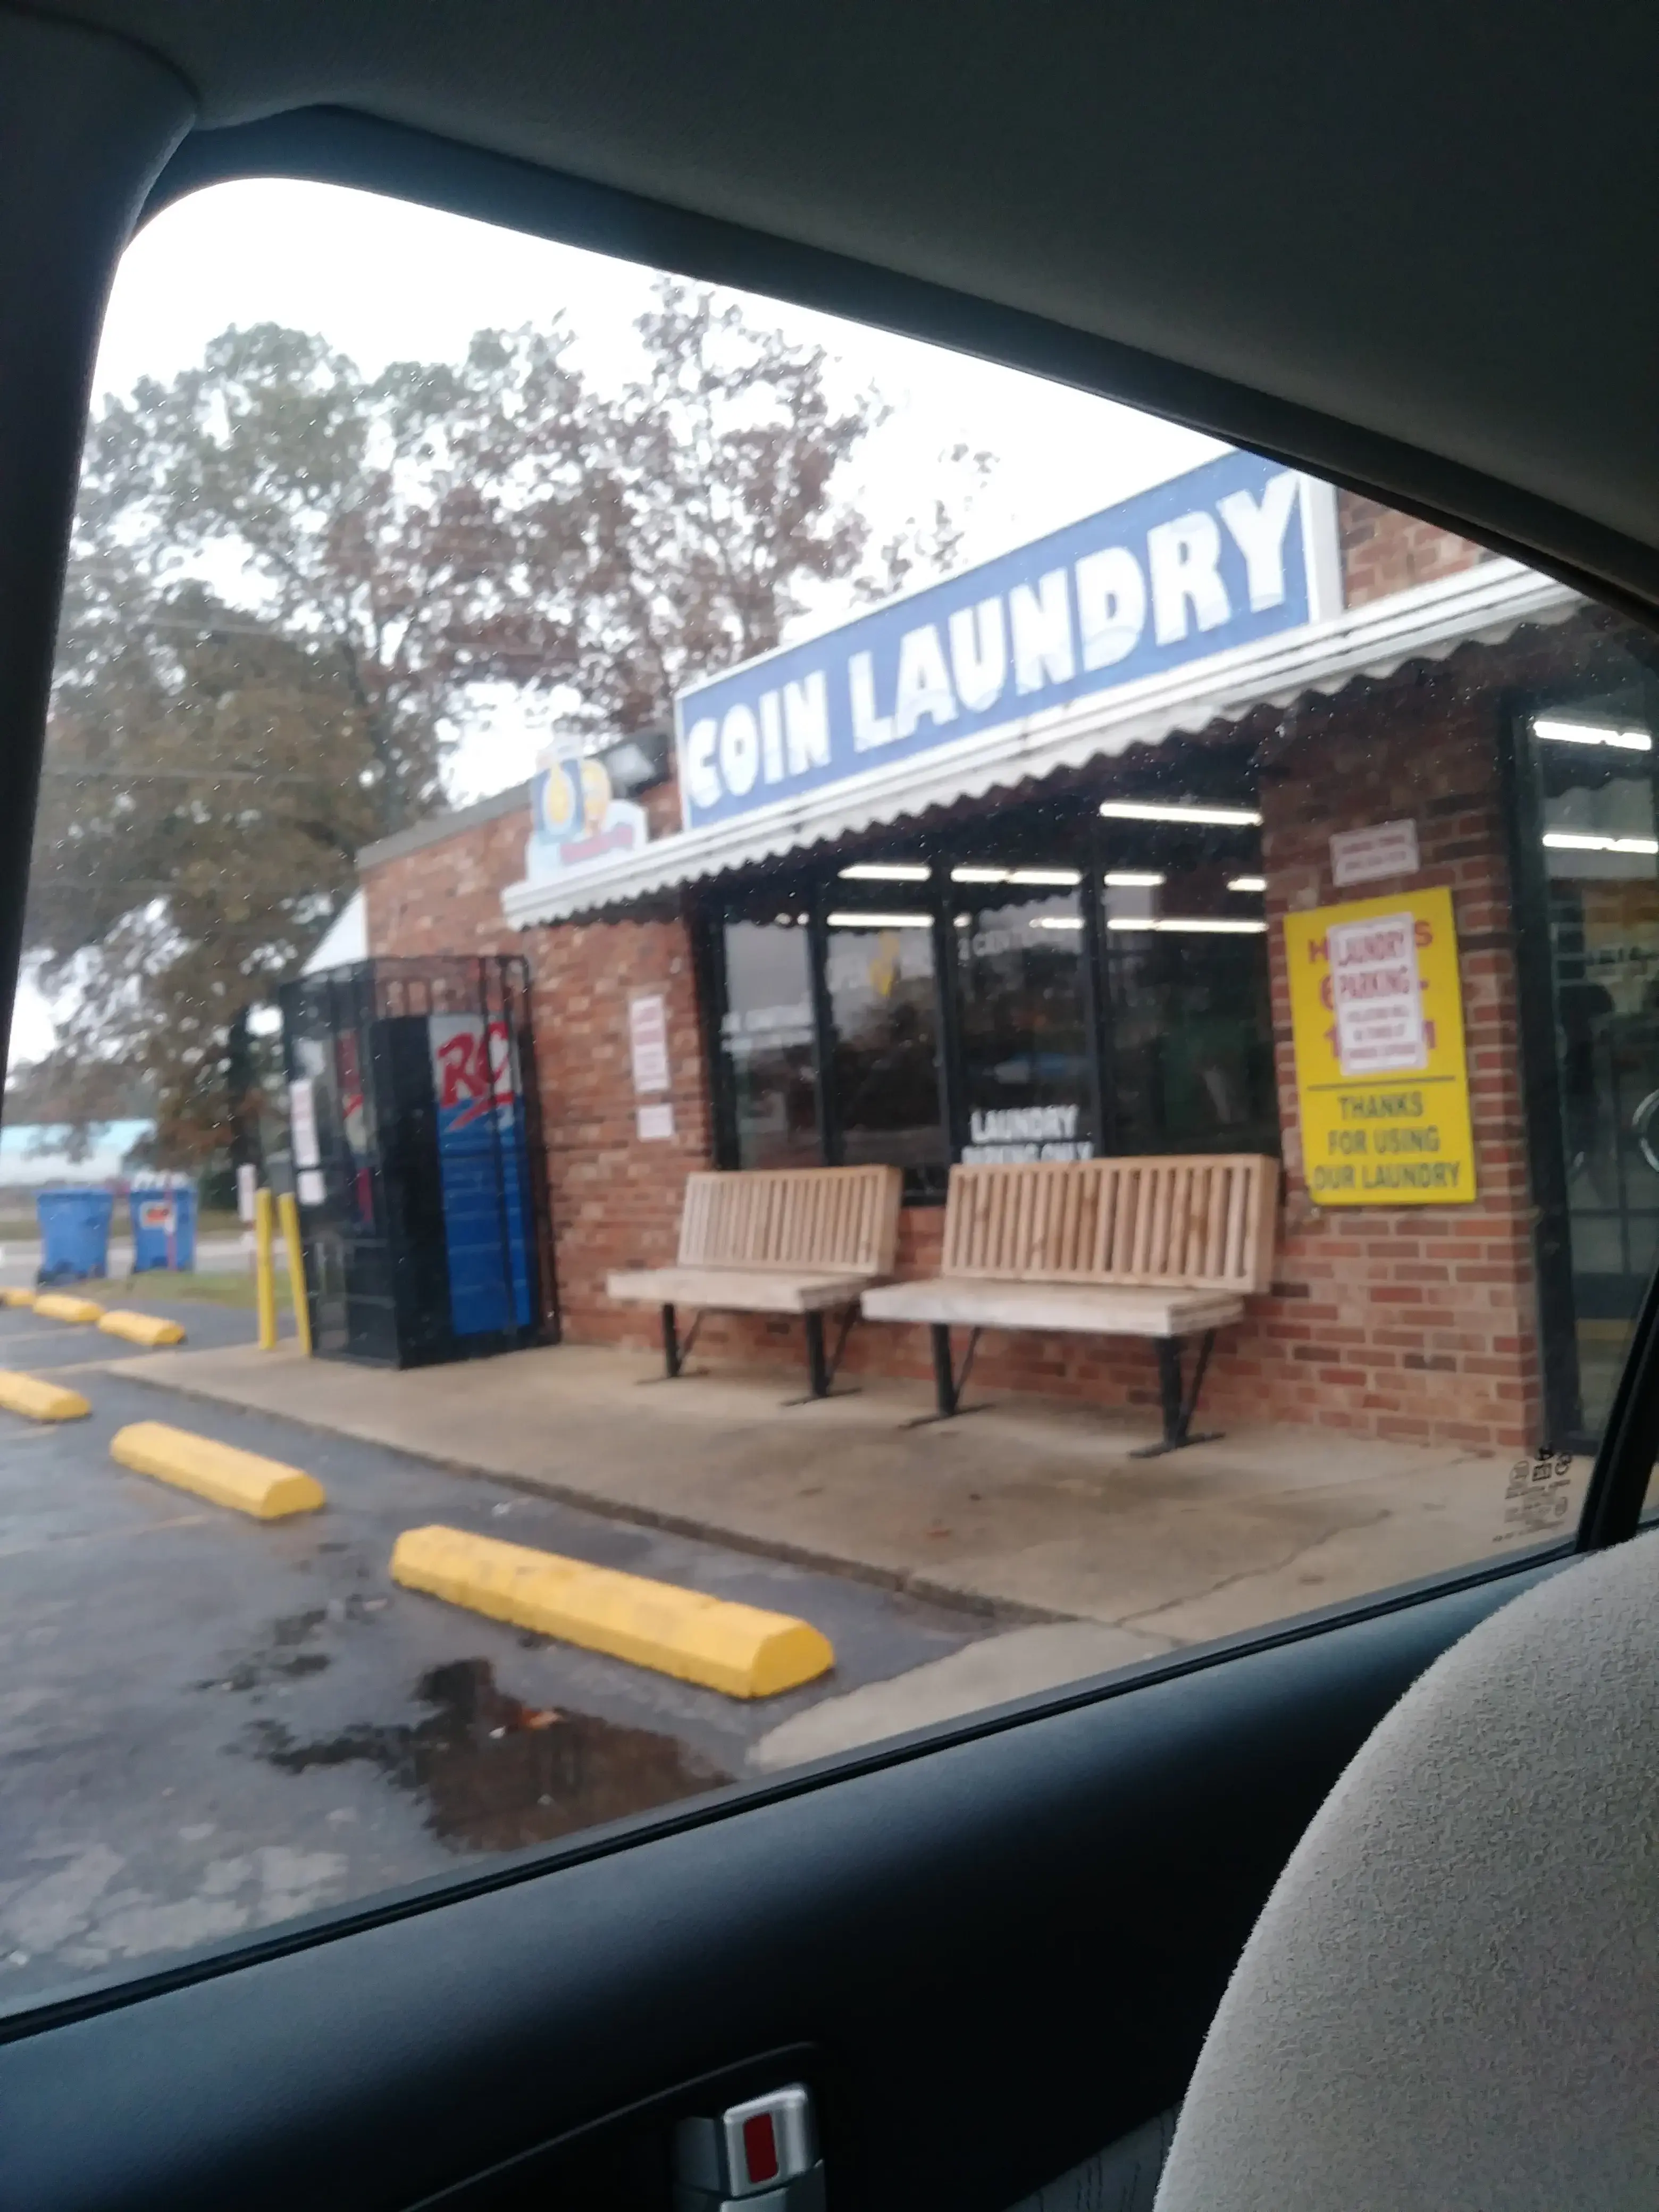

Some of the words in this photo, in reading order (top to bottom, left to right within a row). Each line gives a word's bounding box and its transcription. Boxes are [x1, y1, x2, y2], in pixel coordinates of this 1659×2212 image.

[686, 669, 831, 808] COIN
[847, 470, 1303, 753] LAUNDRY
[1337, 1091, 1423, 1120] THANKS
[971, 1103, 1079, 1143] LAUNDRY
[1328, 1128, 1367, 1155] FOR
[1373, 1124, 1440, 1154] USING
[1313, 1163, 1355, 1190] OUR
[1361, 1161, 1461, 1189] LAUNDRY
